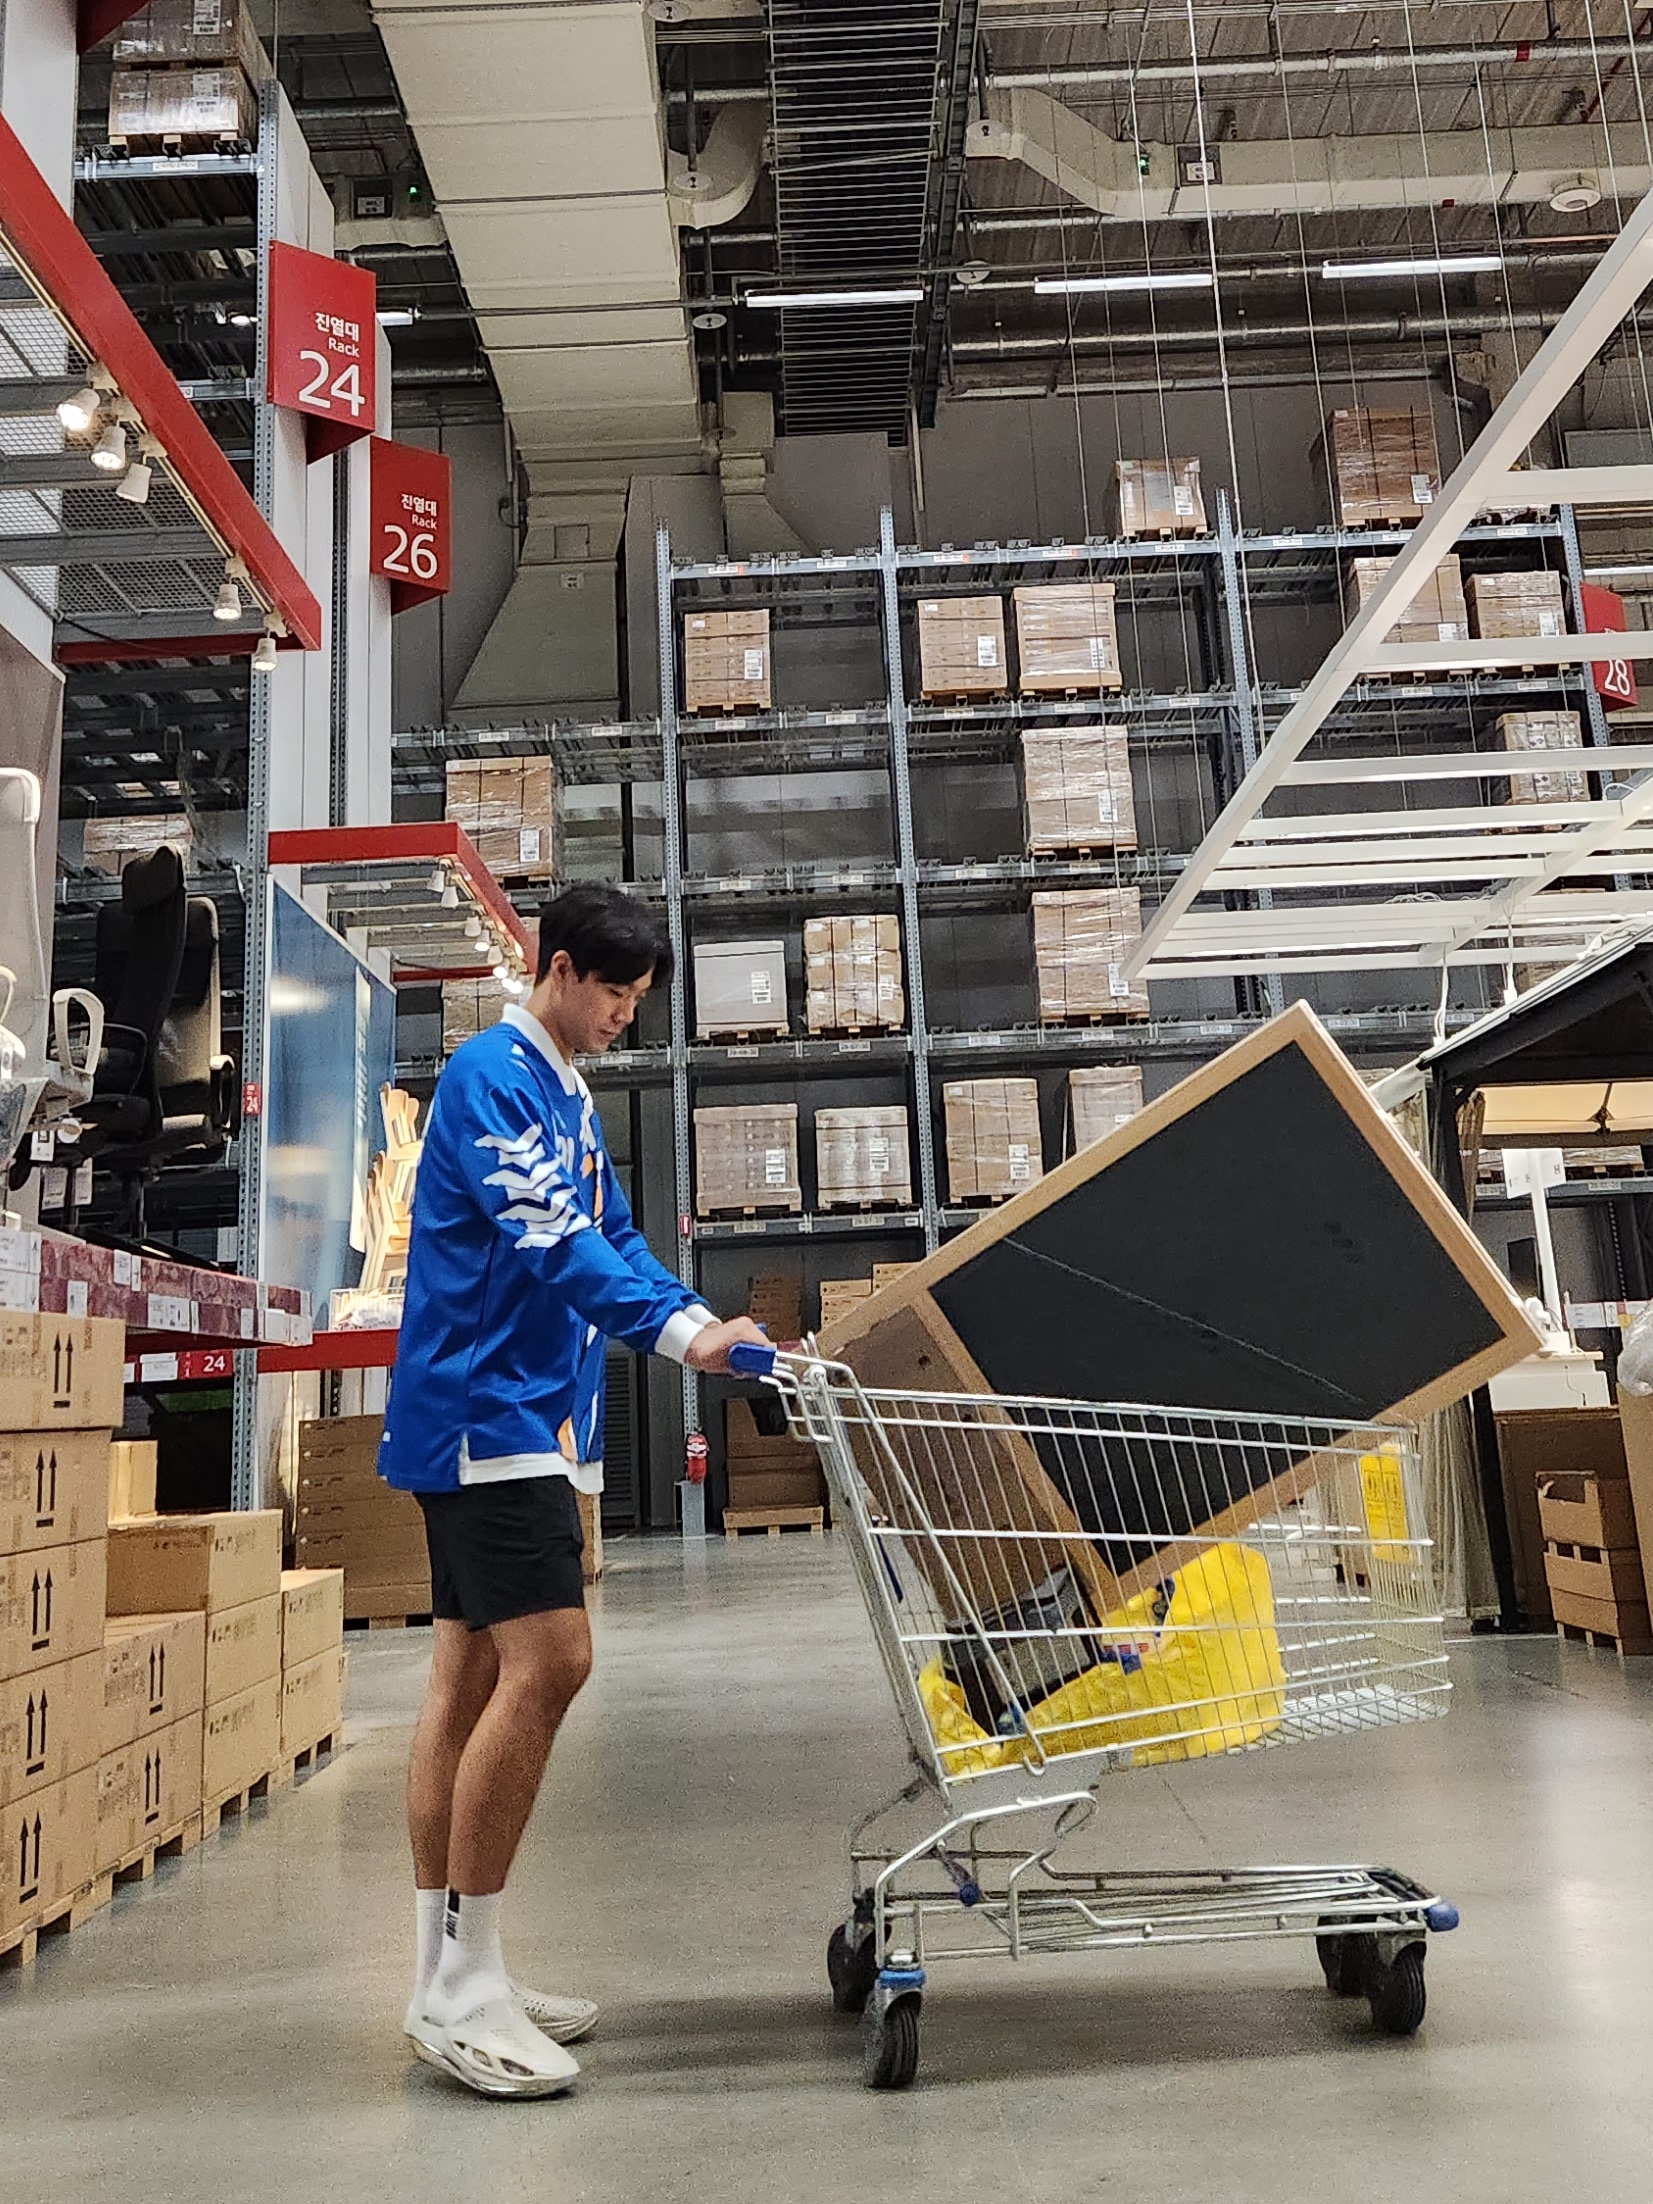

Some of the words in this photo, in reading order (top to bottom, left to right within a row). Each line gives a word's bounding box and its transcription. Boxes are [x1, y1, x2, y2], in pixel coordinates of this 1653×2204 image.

[314, 311, 360, 343] 진열대
[328, 336, 360, 358] Rack
[298, 350, 365, 418] 24
[401, 493, 438, 518] 진열대
[412, 513, 438, 531] Rack
[383, 524, 438, 579] 26
[1604, 659, 1631, 696] 28
[203, 1355, 226, 1373] 24
